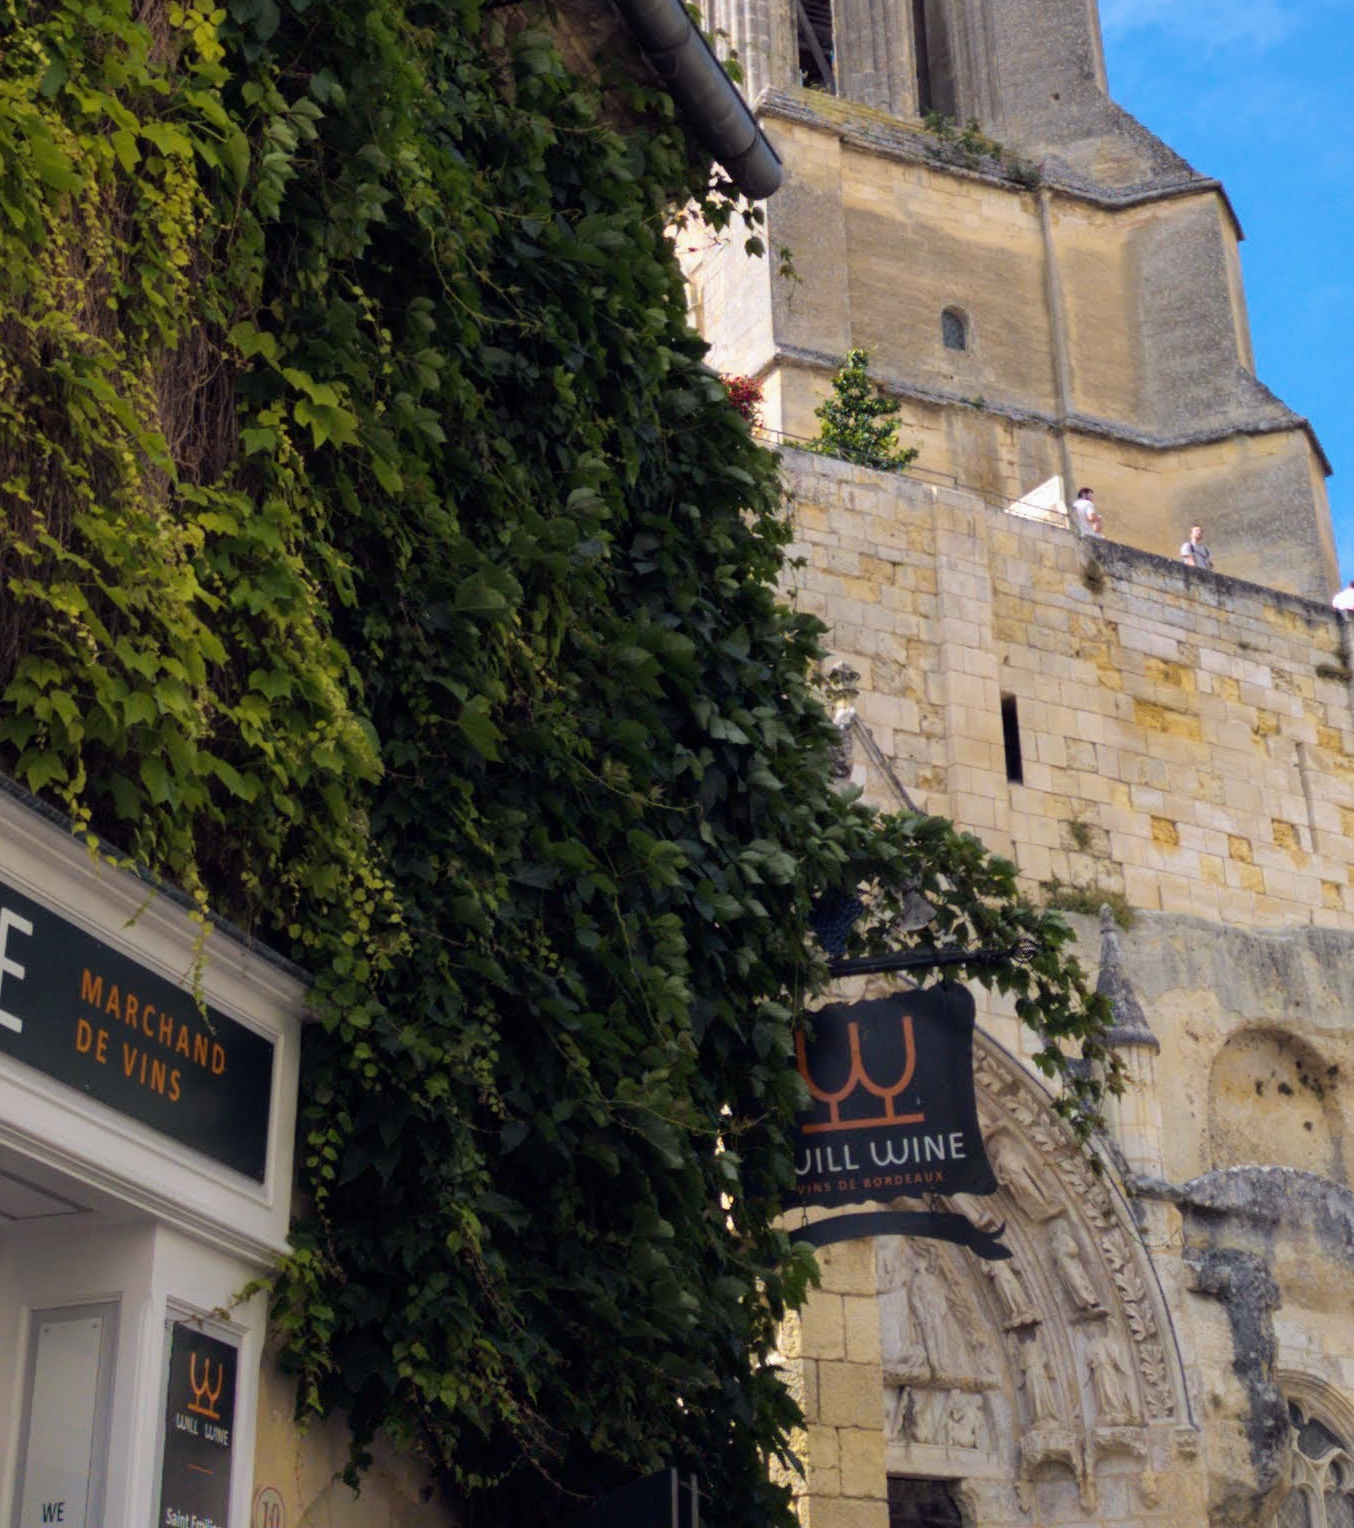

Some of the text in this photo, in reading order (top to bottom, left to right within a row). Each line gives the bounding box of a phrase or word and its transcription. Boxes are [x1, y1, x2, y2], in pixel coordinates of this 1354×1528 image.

[80, 967, 226, 1075] MARCHAND
[76, 1018, 182, 1102] DE VINS
[870, 1132, 967, 1166] WINE
[797, 1171, 944, 1195] VINS DE BORDEAUX
[175, 1412, 229, 1447] WILL WINE
[43, 1501, 66, 1523] WE
[165, 1507, 190, 1528] Saint
